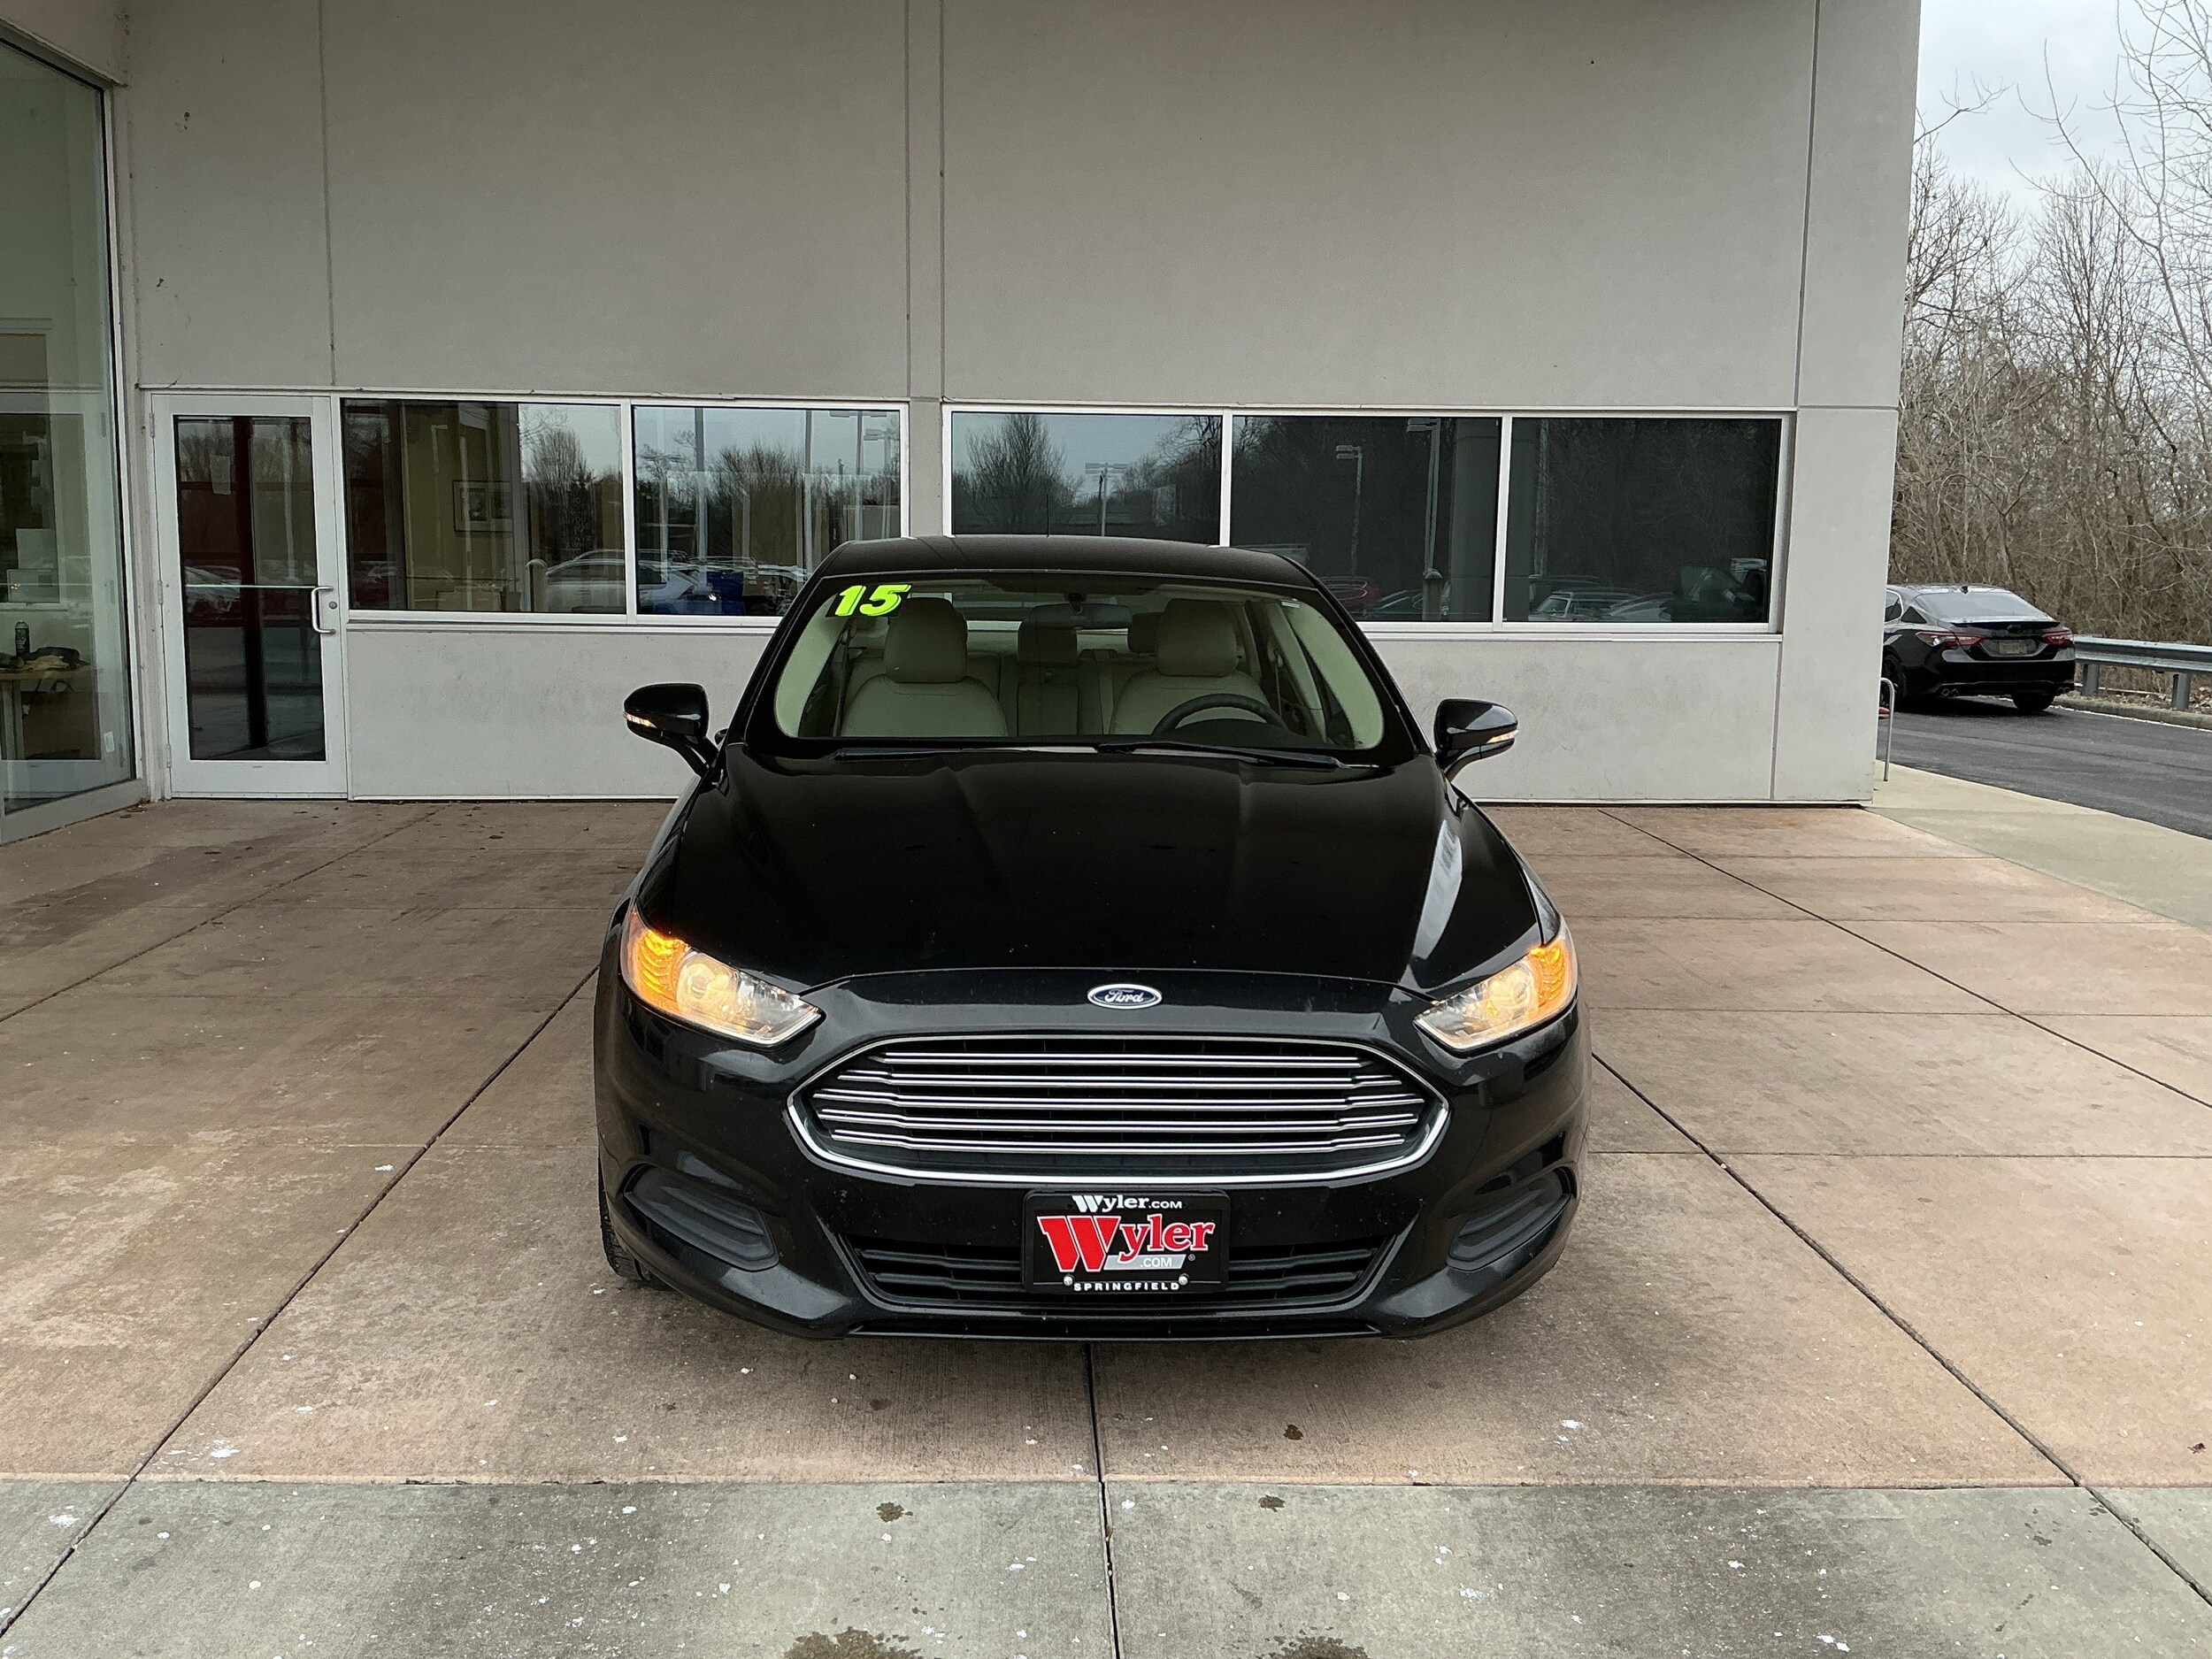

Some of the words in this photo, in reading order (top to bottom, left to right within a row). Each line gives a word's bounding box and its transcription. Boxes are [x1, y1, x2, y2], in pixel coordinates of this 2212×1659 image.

[834, 585, 911, 616] 15
[1104, 989, 1144, 1002] Ford
[1036, 1213, 1216, 1272] Wyler
[1073, 1282, 1180, 1291] SPRINGFIELD
